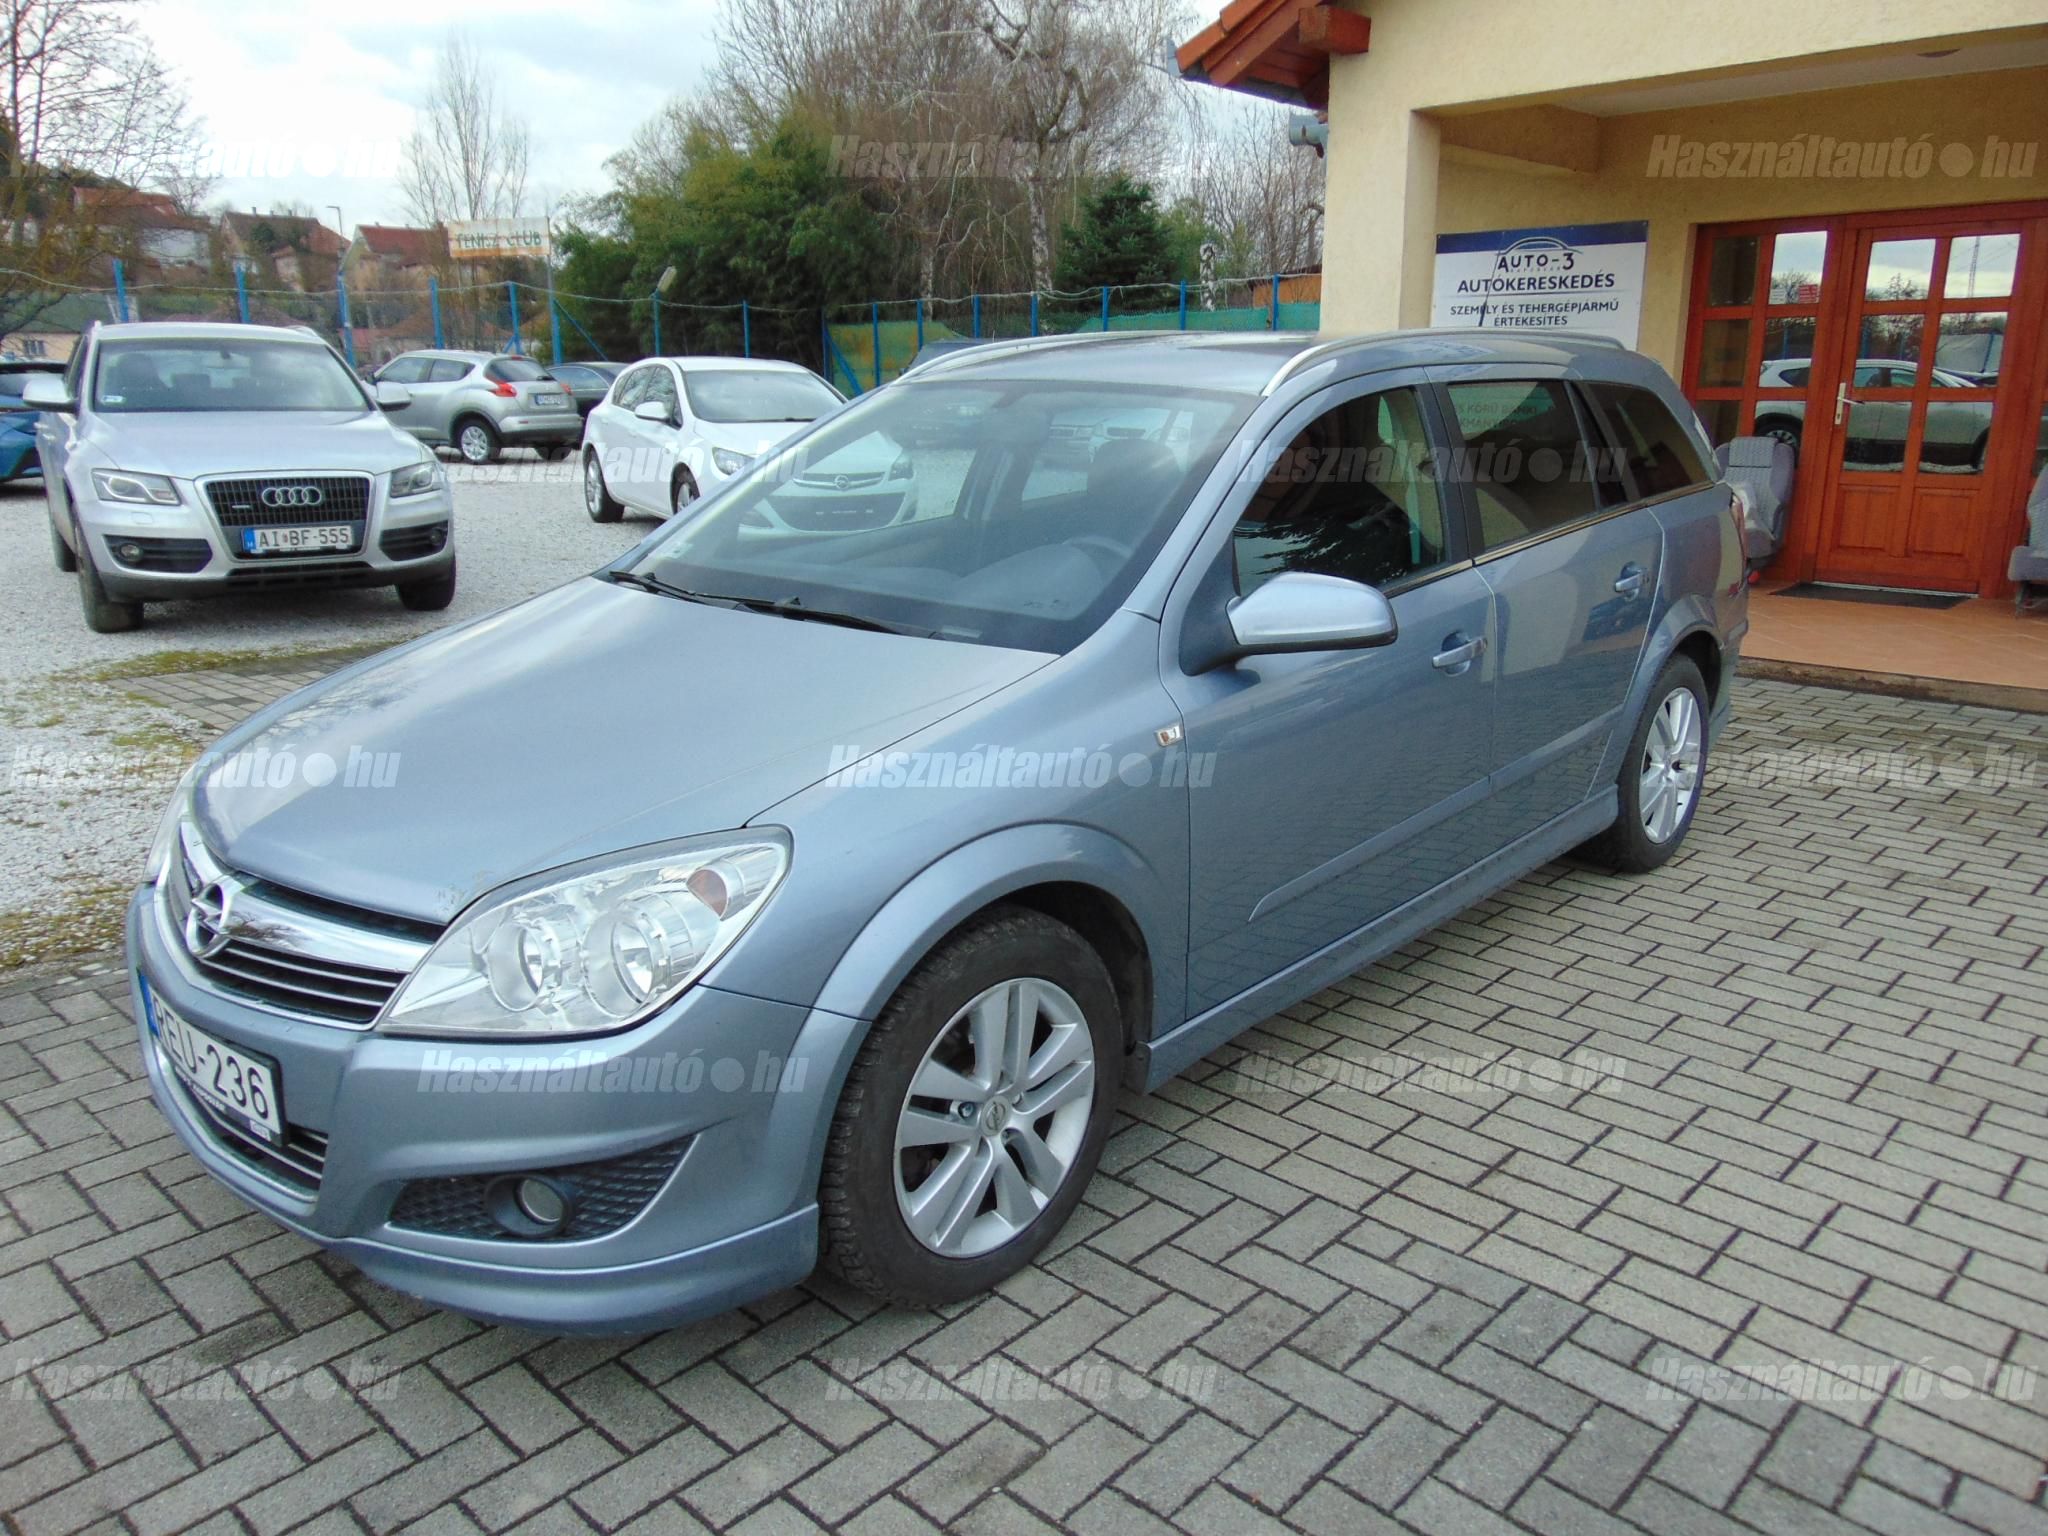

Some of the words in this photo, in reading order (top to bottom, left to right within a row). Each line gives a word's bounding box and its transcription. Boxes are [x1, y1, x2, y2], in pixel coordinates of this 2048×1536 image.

[1457, 270, 1615, 293] AUTÓKERESKEDÉS
[1502, 301, 1515, 315] ÉS
[1519, 299, 1619, 315] TEHERGÉPJÁRMŰ
[1494, 315, 1568, 328] ÉRTÉKESÍTÉS
[260, 531, 280, 547] AI
[289, 528, 349, 546] BF-555
[152, 994, 269, 1120] REU-236
